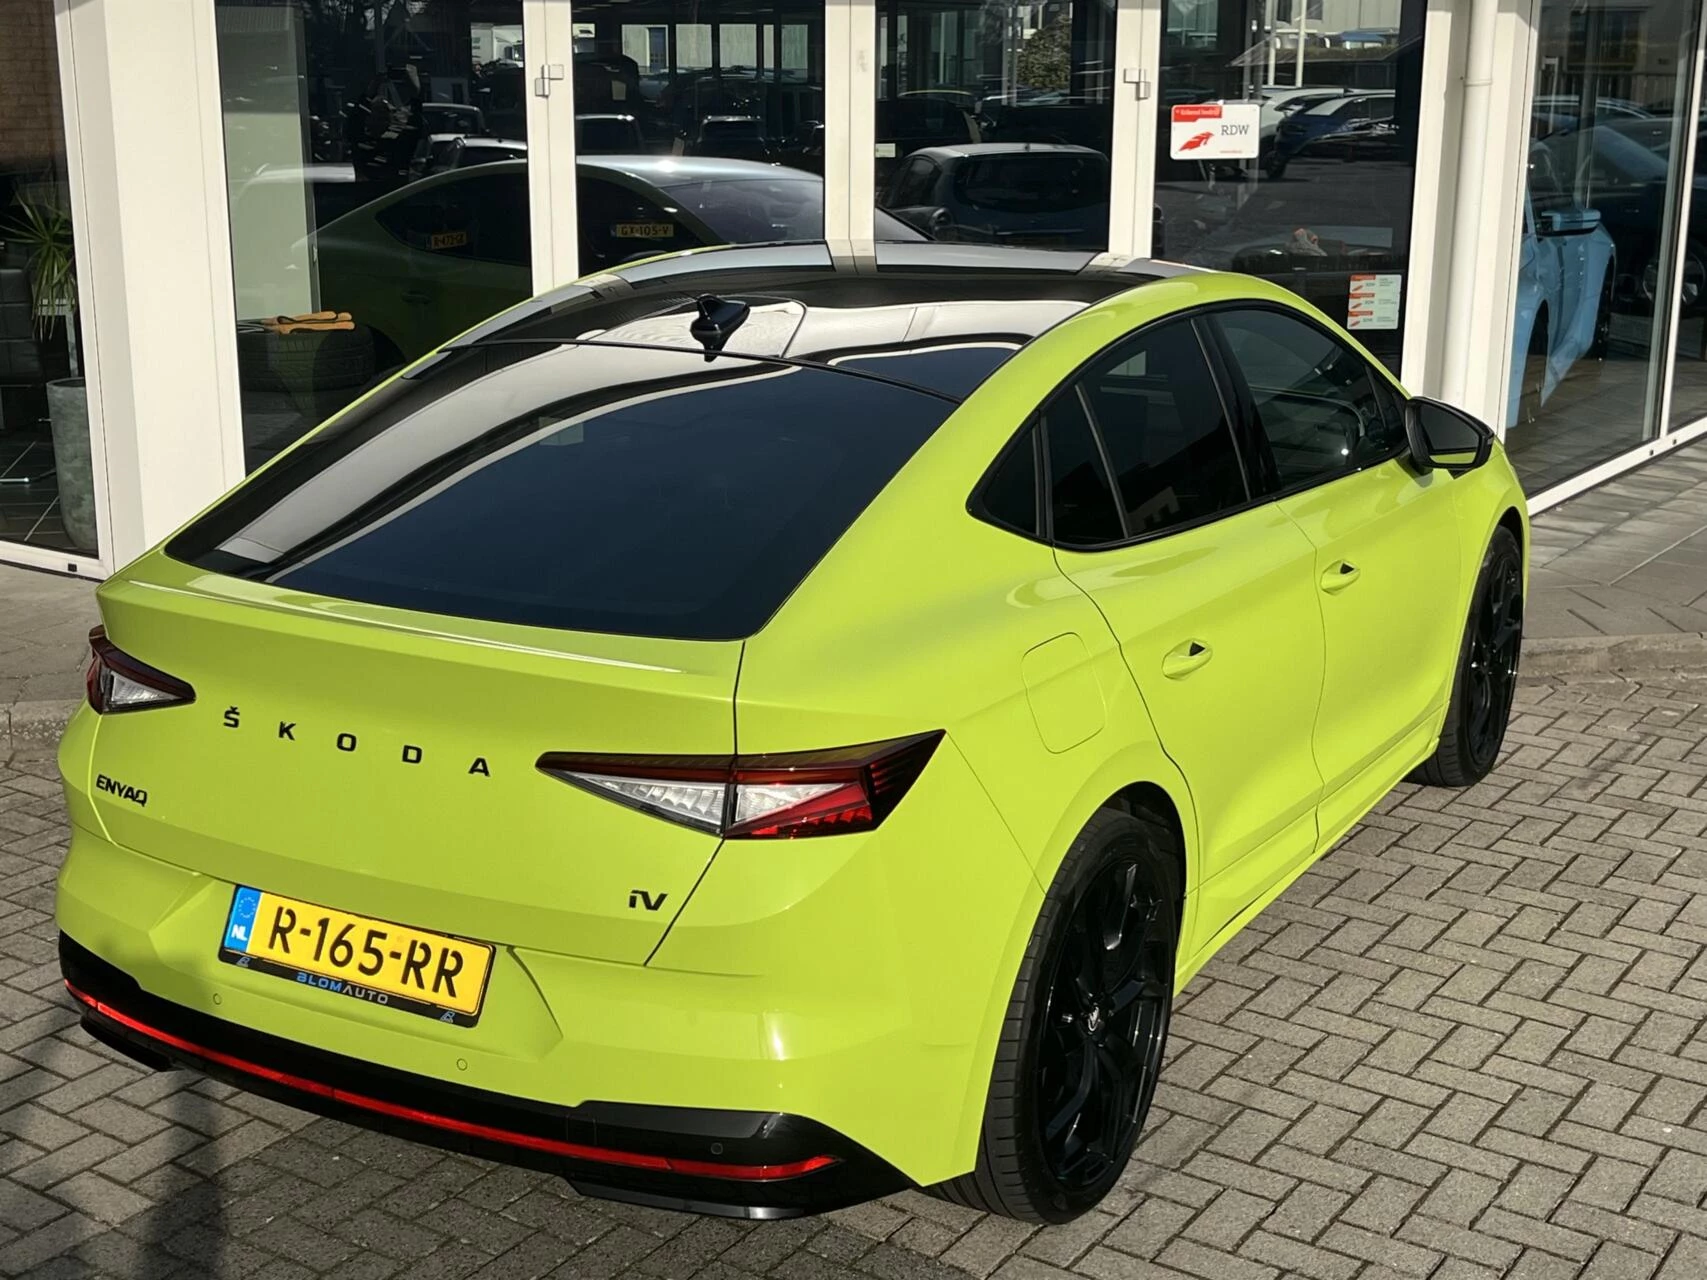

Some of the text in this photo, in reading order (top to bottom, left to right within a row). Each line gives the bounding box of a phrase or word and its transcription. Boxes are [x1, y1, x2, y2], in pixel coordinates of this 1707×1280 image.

[1220, 124, 1250, 137] RDW
[223, 706, 491, 777] ŠKODA
[95, 773, 148, 808] ENYAQ
[230, 923, 248, 942] NL
[267, 905, 465, 999] R-165-RR
